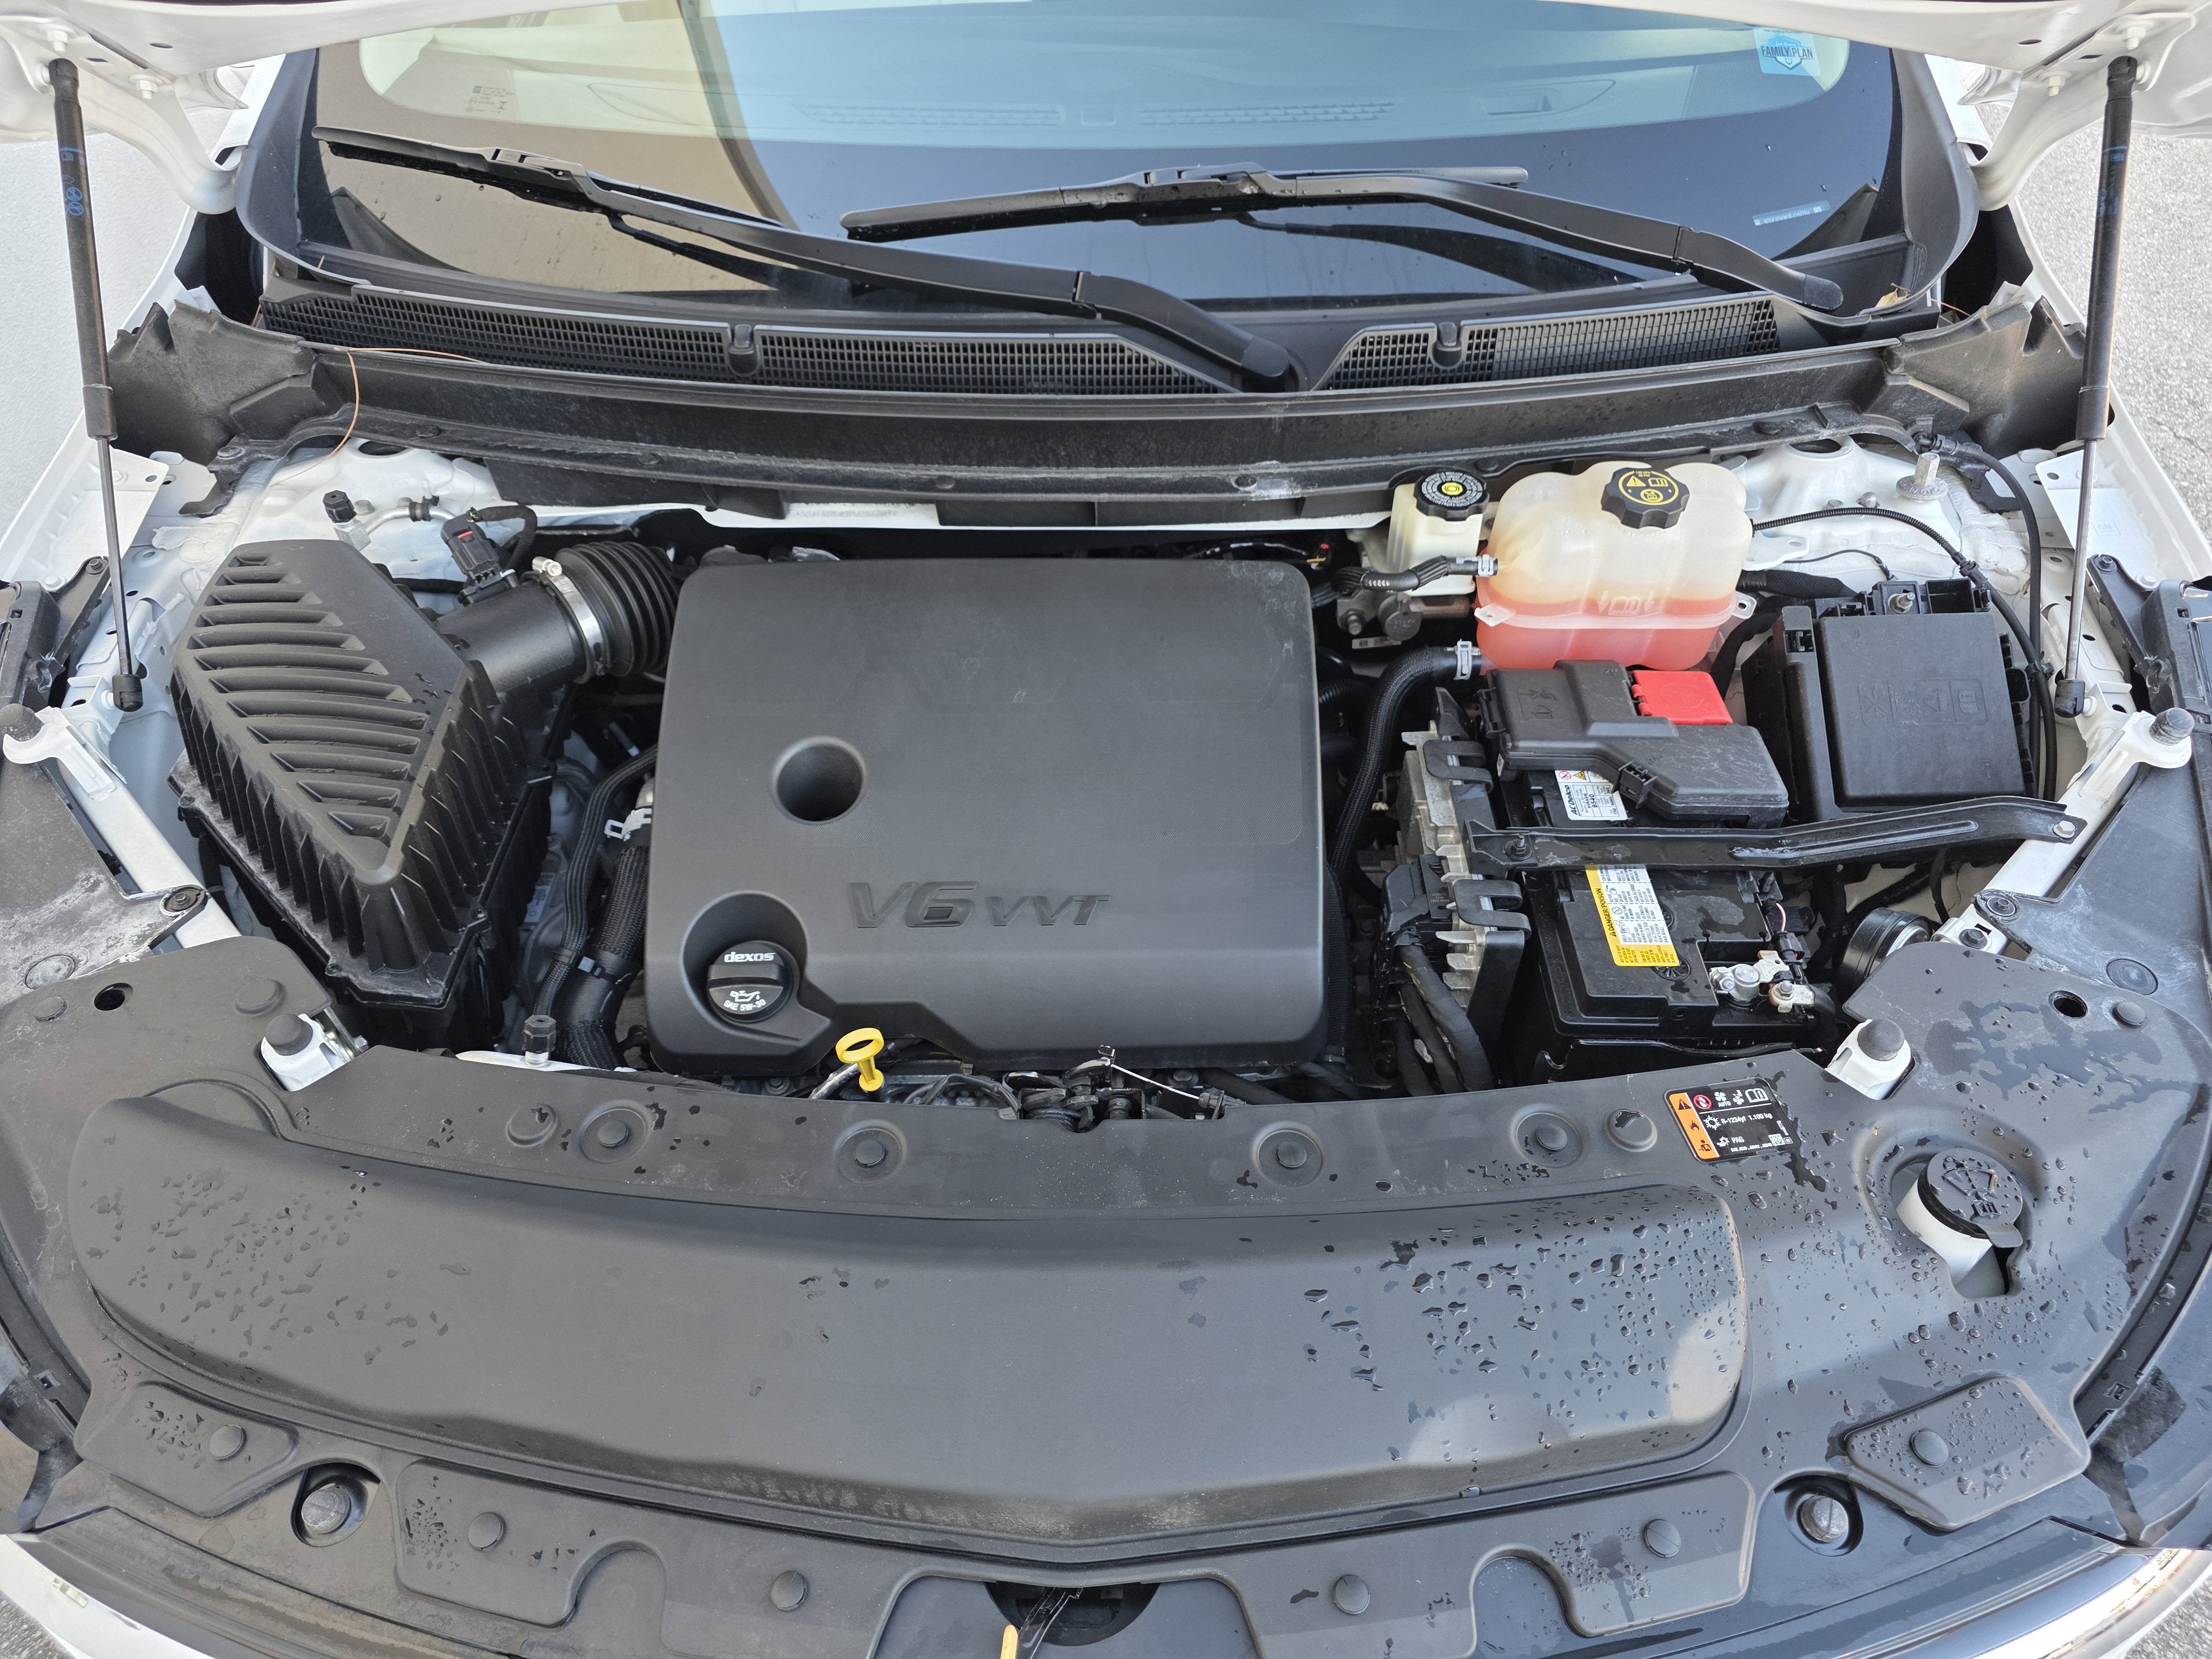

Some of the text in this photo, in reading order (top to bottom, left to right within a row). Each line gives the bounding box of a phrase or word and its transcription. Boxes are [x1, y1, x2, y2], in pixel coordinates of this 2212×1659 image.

[1761, 46, 1813, 58] FAMILY PLAN
[1588, 794, 1598, 808] 8540
[847, 881, 1111, 928] V6 VVT
[1596, 888, 1614, 932] DANGER/POISON
[724, 951, 776, 963] dexos
[723, 999, 766, 1011] SAE 5W-30
